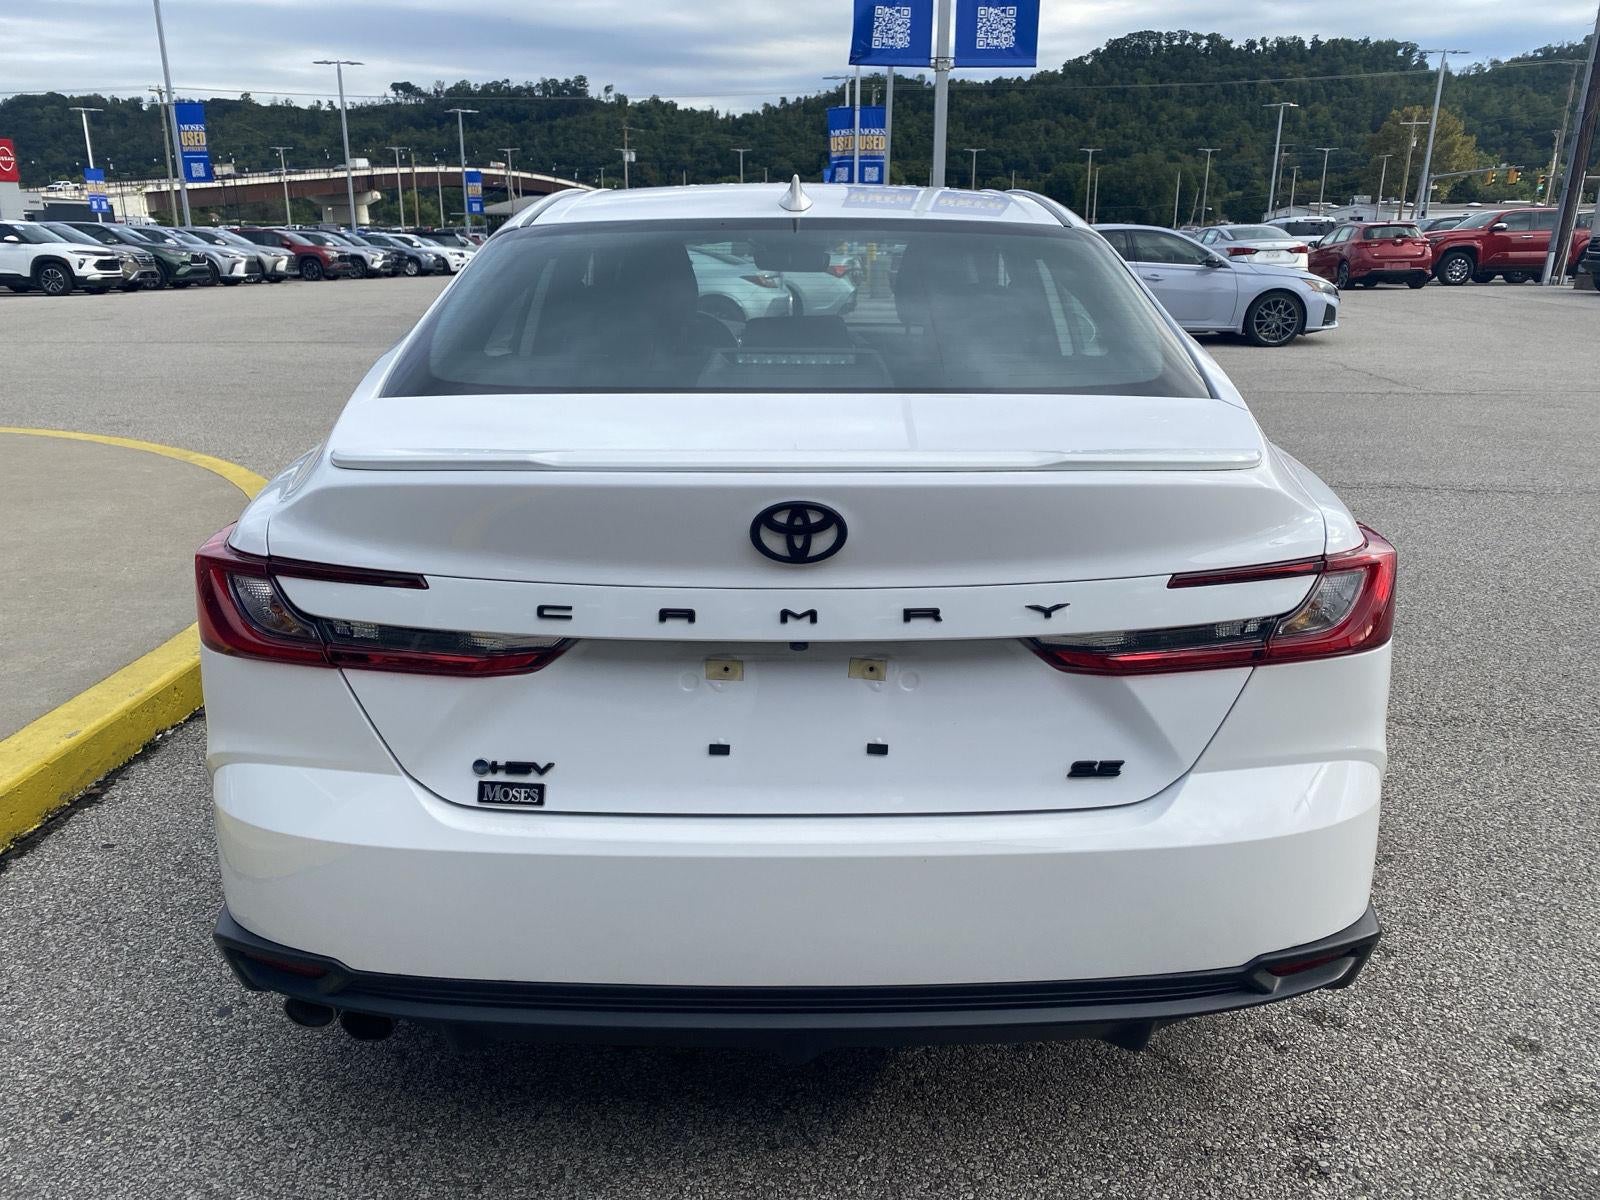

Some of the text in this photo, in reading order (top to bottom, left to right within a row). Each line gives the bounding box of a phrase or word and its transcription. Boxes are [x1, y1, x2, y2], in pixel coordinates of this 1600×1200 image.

[181, 132, 206, 146] USED
[830, 136, 854, 151] USED
[860, 136, 885, 150] USED
[537, 603, 1070, 624] CAMRY
[1066, 760, 1125, 778] SE
[482, 784, 539, 803] MOSES
